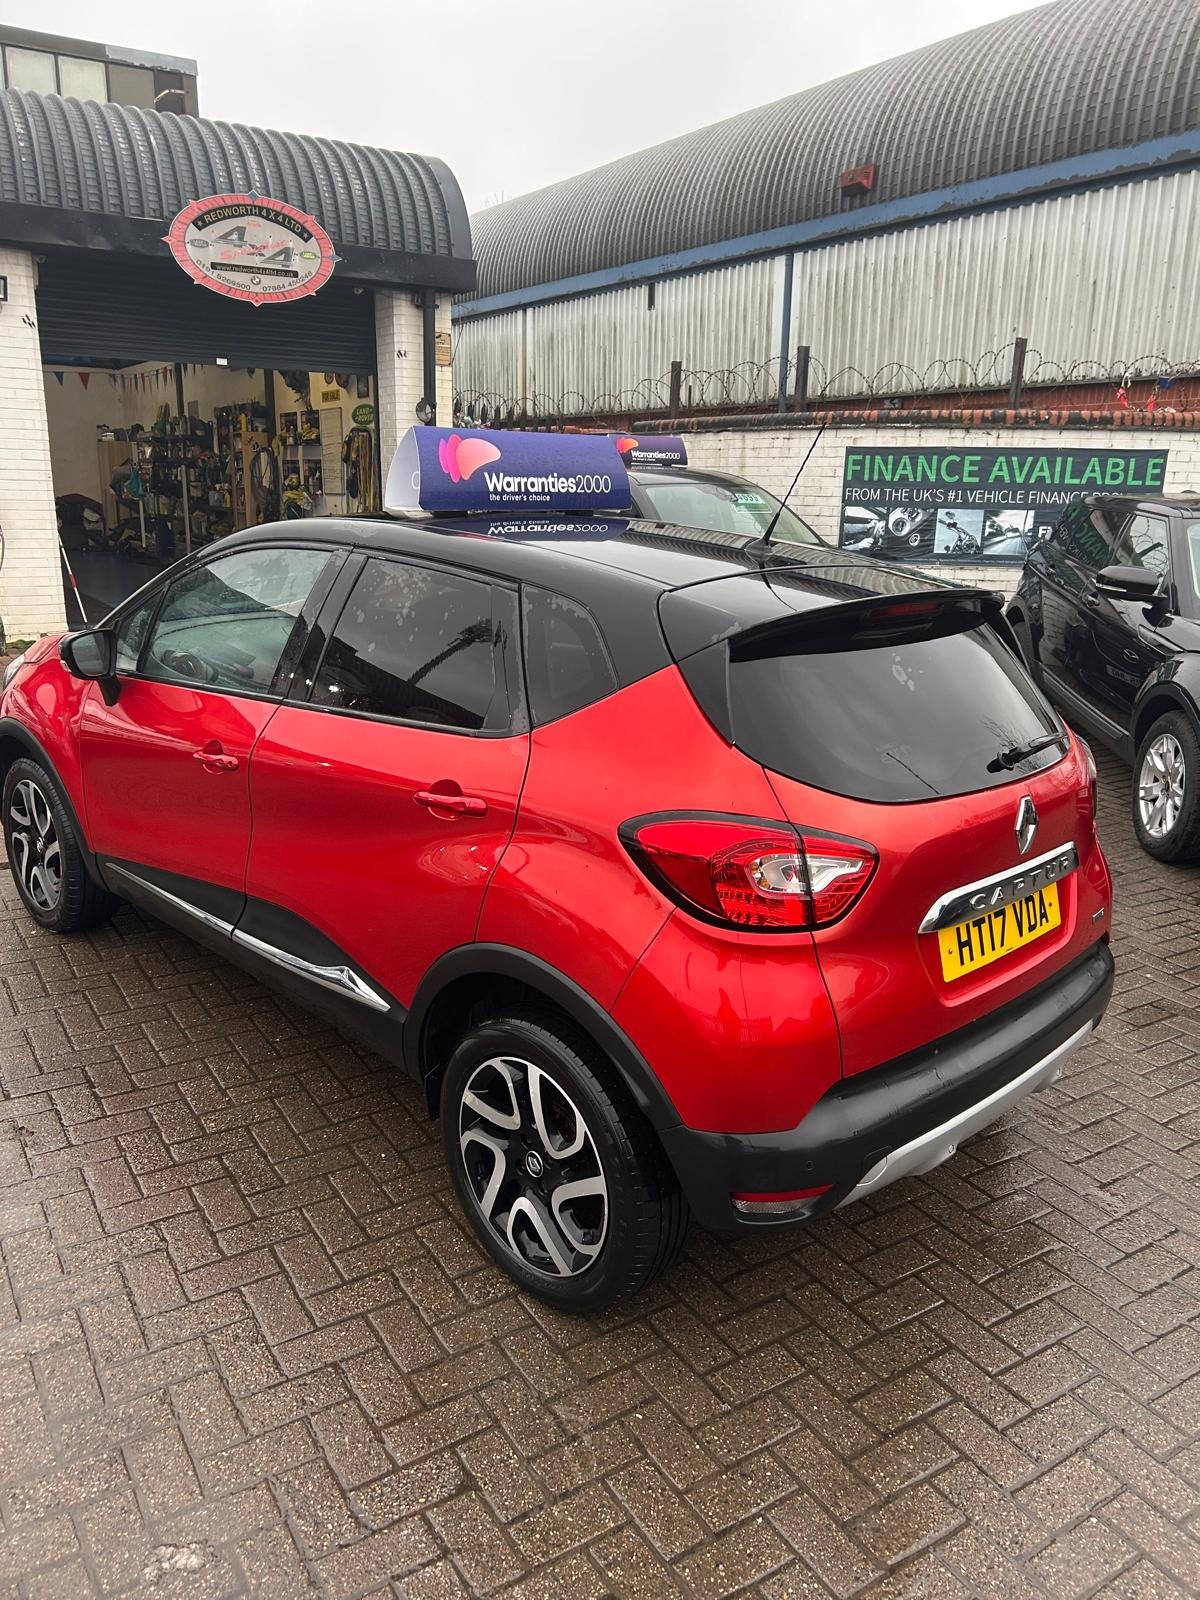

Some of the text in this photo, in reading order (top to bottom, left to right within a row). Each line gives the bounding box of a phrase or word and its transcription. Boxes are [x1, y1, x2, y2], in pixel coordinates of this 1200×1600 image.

[204, 206, 259, 224] REDWORTH
[261, 208, 267, 217] 4
[268, 211, 275, 220] X
[277, 215, 283, 224] 4
[284, 218, 302, 233] LTD
[630, 450, 681, 459] Warranties2000
[484, 471, 612, 494] Warranties2000
[846, 454, 1164, 487] FINANCE AVAILABLE
[845, 487, 880, 501] FROM
[884, 488, 910, 502] THE
[913, 488, 945, 502] UK'S
[947, 490, 963, 503] #1
[967, 490, 1025, 504] VEHICLE
[969, 857, 1069, 911] CAPTUR
[955, 889, 1050, 967] HT17 VDA
